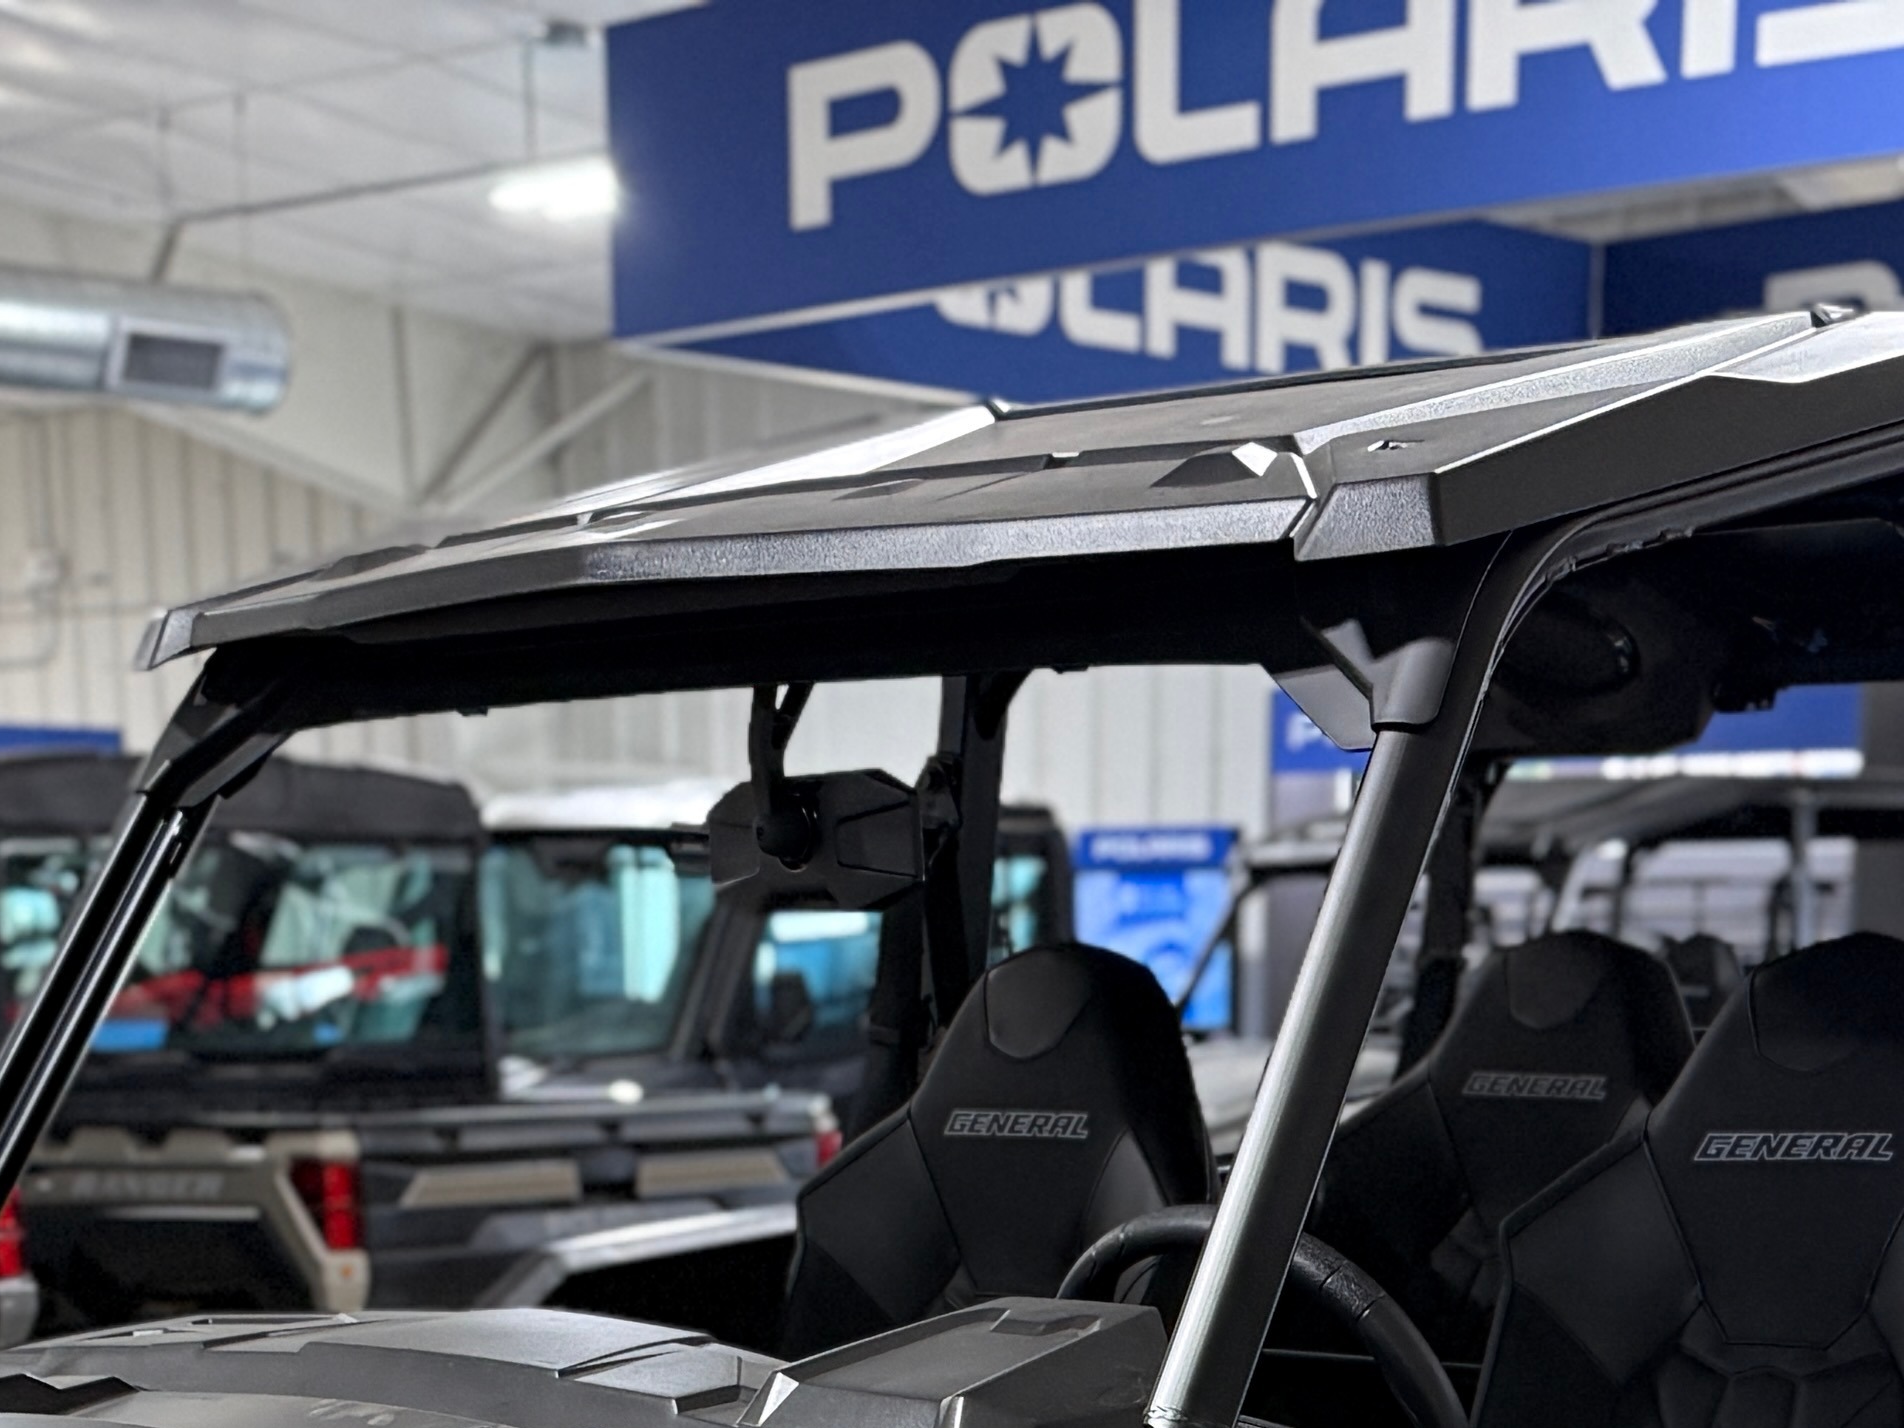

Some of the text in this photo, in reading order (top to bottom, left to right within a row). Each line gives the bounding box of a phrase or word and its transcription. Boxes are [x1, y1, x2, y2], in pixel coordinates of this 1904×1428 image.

[934, 240, 1483, 372] OLARIS
[1461, 1070, 1608, 1101] GENERAL
[943, 1109, 1089, 1140] GENERAL
[1692, 1131, 1896, 1163] GENERAL
